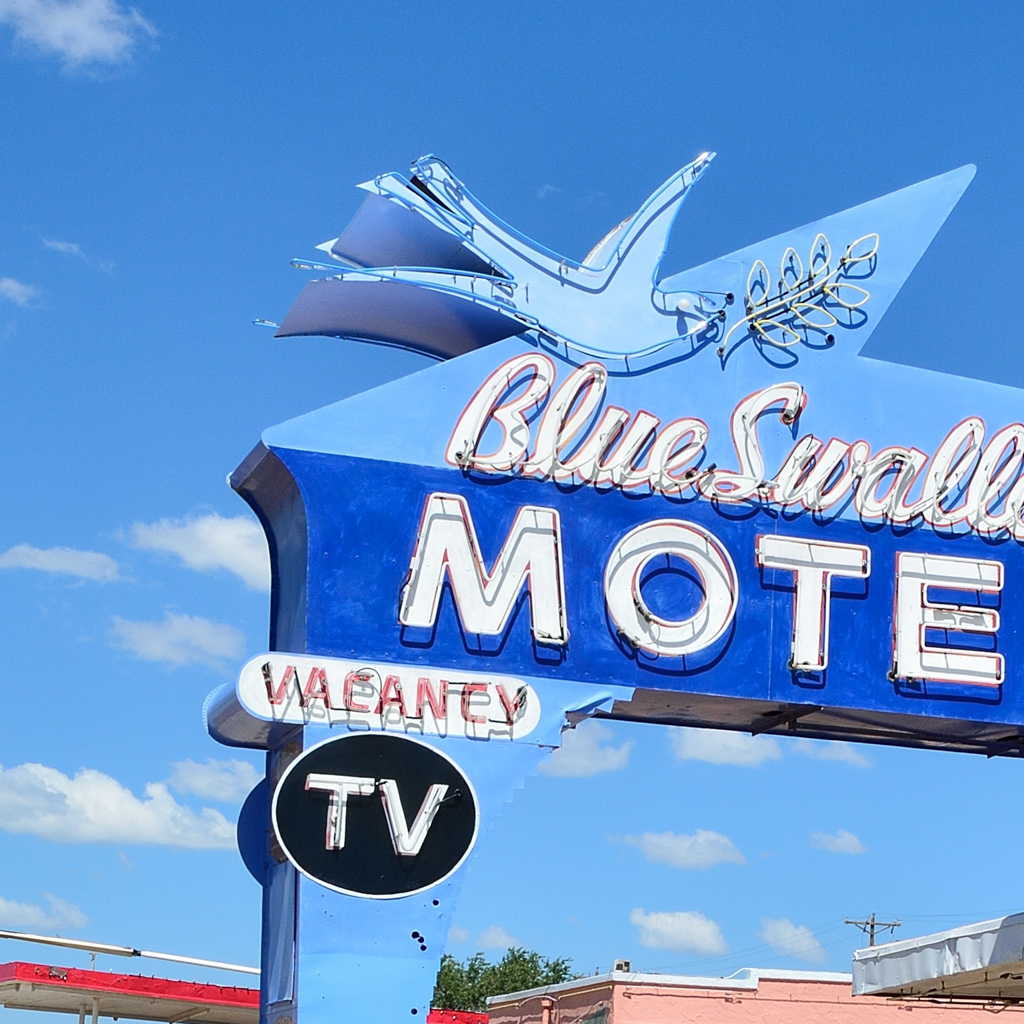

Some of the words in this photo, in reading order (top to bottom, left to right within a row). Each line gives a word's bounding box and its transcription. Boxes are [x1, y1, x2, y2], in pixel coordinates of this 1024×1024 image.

[446, 352, 710, 495] Blue
[262, 661, 527, 726] VACANCY
[305, 773, 449, 856] TV
